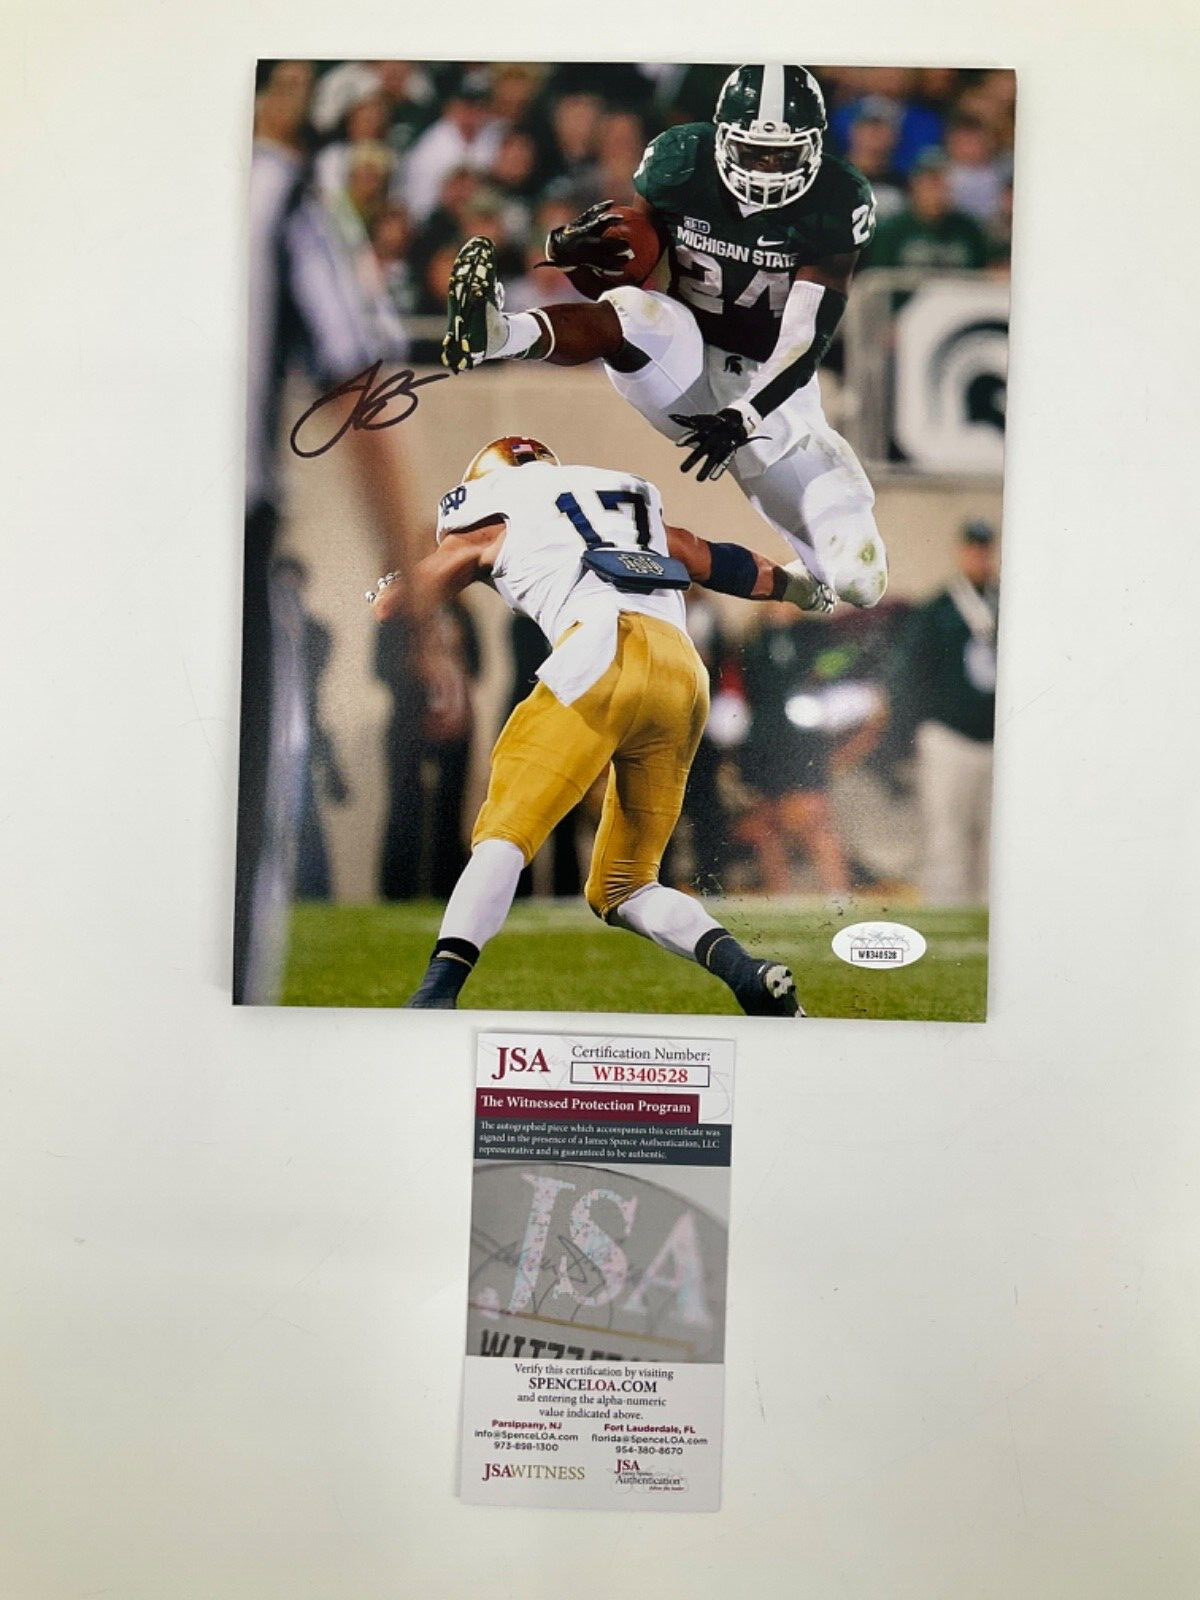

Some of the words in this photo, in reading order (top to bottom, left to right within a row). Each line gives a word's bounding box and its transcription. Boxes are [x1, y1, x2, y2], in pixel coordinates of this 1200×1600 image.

[677, 226, 749, 263] MICHIGAN
[675, 244, 790, 318] 24
[555, 489, 652, 550] 17
[858, 950, 897, 960] WB340528
[572, 1045, 650, 1061] Certification
[654, 1048, 710, 1062] Number:
[492, 1047, 550, 1079] JSA
[593, 1066, 688, 1083] WB340528
[481, 1095, 503, 1107] The
[507, 1096, 568, 1109] Witnessed
[572, 1098, 634, 1111] Protection
[639, 1100, 691, 1115] Program
[481, 1121, 494, 1130] The
[497, 1122, 546, 1133] autographed
[548, 1124, 568, 1133] piece
[570, 1124, 594, 1133] which
[596, 1127, 647, 1136] accompanies
[649, 1126, 664, 1134] this
[665, 1127, 704, 1136] certificate
[480, 1133, 505, 1143] signed
[517, 1134, 530, 1143] the
[531, 1136, 566, 1145] presence
[568, 1136, 577, 1144] of
[585, 1136, 608, 1145] James
[610, 1138, 636, 1148] Spence
[640, 1138, 700, 1149] Authentication,
[702, 1140, 719, 1149] LLC
[479, 1146, 534, 1155] representative
[536, 1147, 551, 1155] and
[561, 1148, 605, 1158] guaranteed
[617, 1149, 627, 1157] be
[628, 1149, 666, 1159] authentic.
[515, 1363, 542, 1376] Verify
[545, 1363, 563, 1374] this
[565, 1365, 622, 1376] certification
[625, 1367, 636, 1379] by
[639, 1367, 674, 1380] visiting
[528, 1377, 657, 1393] SPENCELOA.COM
[517, 1392, 535, 1402] and
[537, 1394, 577, 1406] entering
[579, 1394, 595, 1404] the
[539, 1407, 564, 1417] value
[566, 1407, 610, 1418] indicated
[613, 1409, 643, 1420] above.
[491, 1419, 547, 1430] Parsippany,
[549, 1422, 562, 1430] NJ
[604, 1423, 624, 1432] Fort
[627, 1424, 681, 1435] Lauderdale,
[683, 1426, 696, 1434] FL
[474, 1430, 579, 1442] info@SpenceLOA.com
[591, 1433, 708, 1445] florida@SpenceLOA.com
[615, 1445, 683, 1455] 954-380-8670
[614, 1459, 640, 1474] JSA
